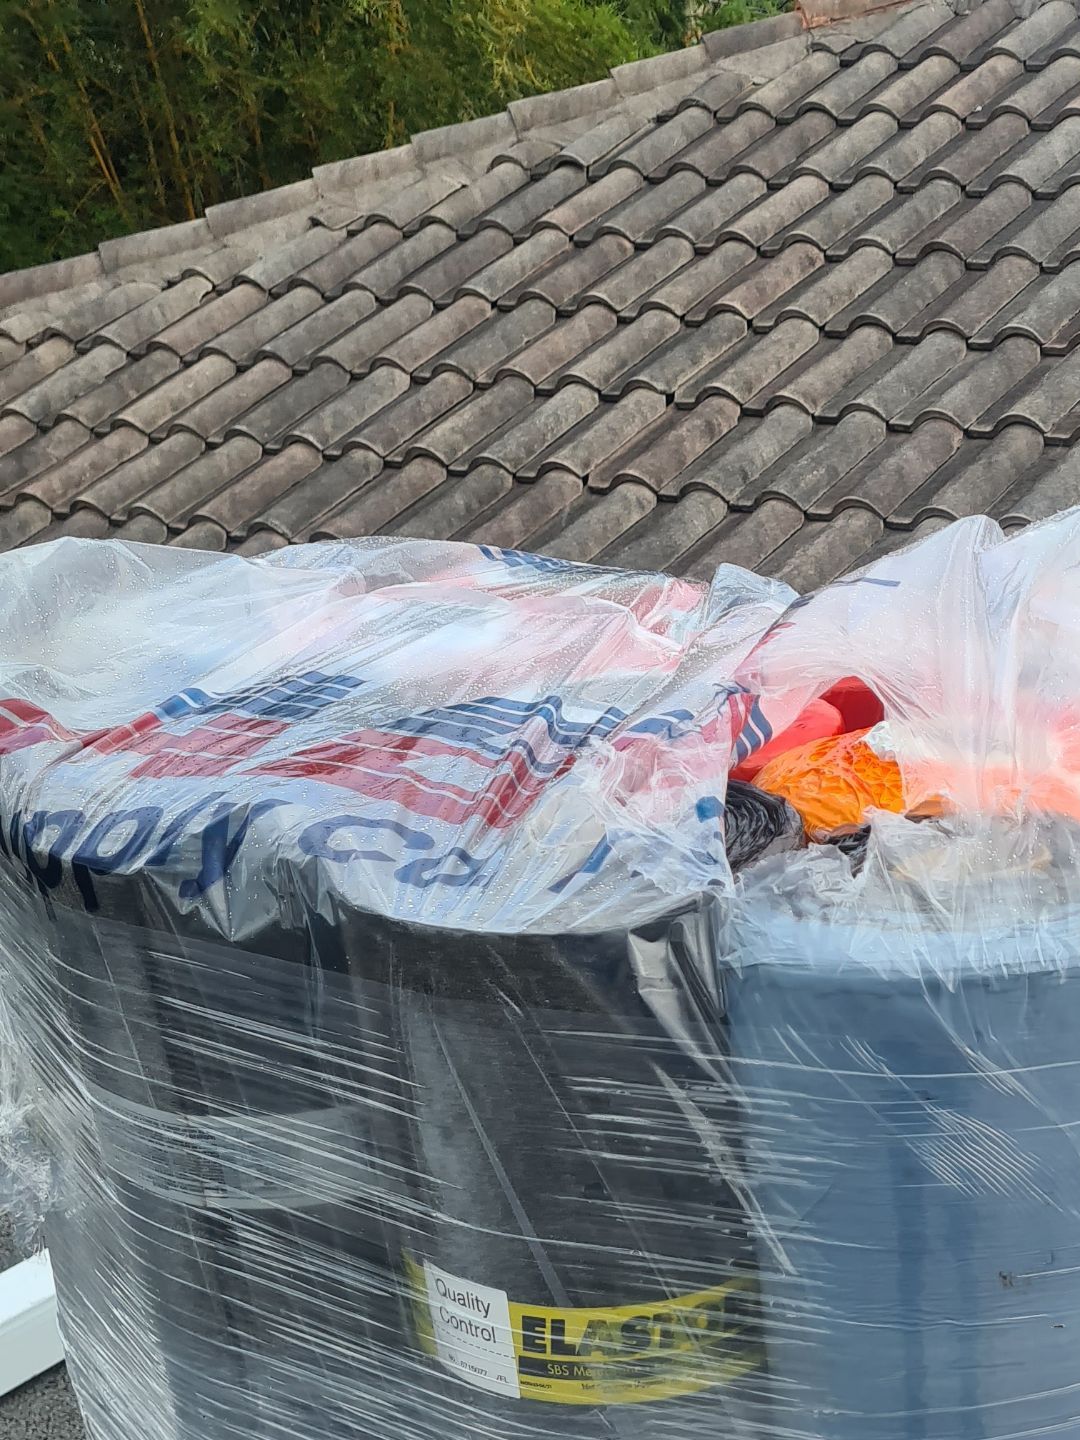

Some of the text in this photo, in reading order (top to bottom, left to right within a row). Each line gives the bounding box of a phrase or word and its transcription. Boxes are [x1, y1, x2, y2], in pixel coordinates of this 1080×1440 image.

[435, 1278, 491, 1318] Quality
[440, 1306, 497, 1343] Control
[547, 1363, 571, 1376] SBS
